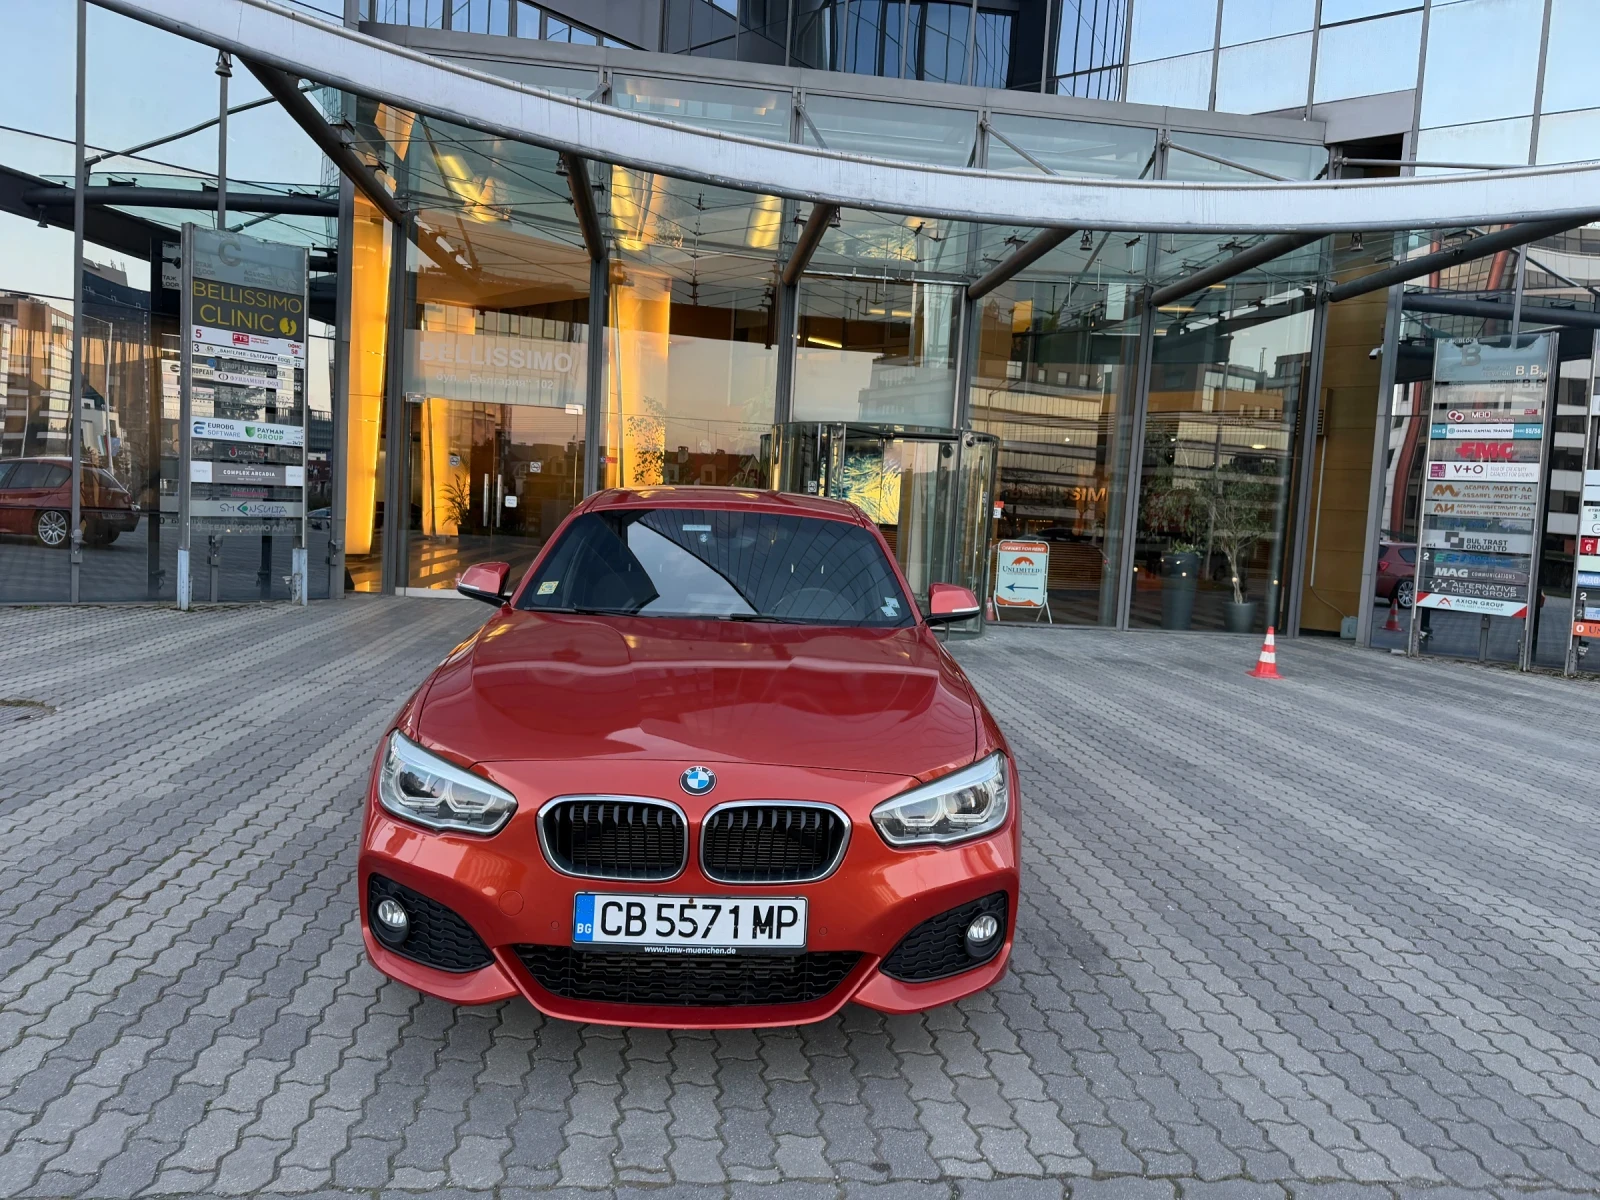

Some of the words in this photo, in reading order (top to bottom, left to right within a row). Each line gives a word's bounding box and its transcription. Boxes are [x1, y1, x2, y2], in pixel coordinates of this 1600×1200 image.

[193, 281, 302, 313] BELLISSIMO
[200, 304, 275, 332] CLINIC
[195, 329, 202, 338] 5
[233, 333, 249, 342] FTS
[194, 344, 200, 352] 3
[419, 341, 573, 373] BELLISSIMO
[1461, 344, 1481, 367] B
[535, 379, 554, 390] 102
[207, 429, 241, 438] SOFTWARE
[257, 427, 284, 435] PAYMAN
[1453, 464, 1484, 475] V+O
[1483, 538, 1508, 546] TRAST
[1585, 543, 1592, 551] 6
[1466, 544, 1493, 552] GROUP
[1423, 552, 1430, 560] 2
[1434, 567, 1469, 578] MAG
[1471, 572, 1516, 580] COMMUNICATIONS
[1452, 581, 1517, 593] ALTERNATIVE
[1451, 587, 1482, 595] MEDIA
[1482, 590, 1517, 598] GROUP
[1579, 591, 1587, 601] 2
[1479, 600, 1505, 608] GROUP
[1576, 624, 1585, 633] 0
[684, 766, 715, 776] BMW
[600, 901, 647, 937] CB
[656, 904, 741, 939] 5571
[751, 905, 799, 940] MP
[576, 922, 592, 934] BG
[644, 945, 737, 956] www.bmw-muenchen.de
